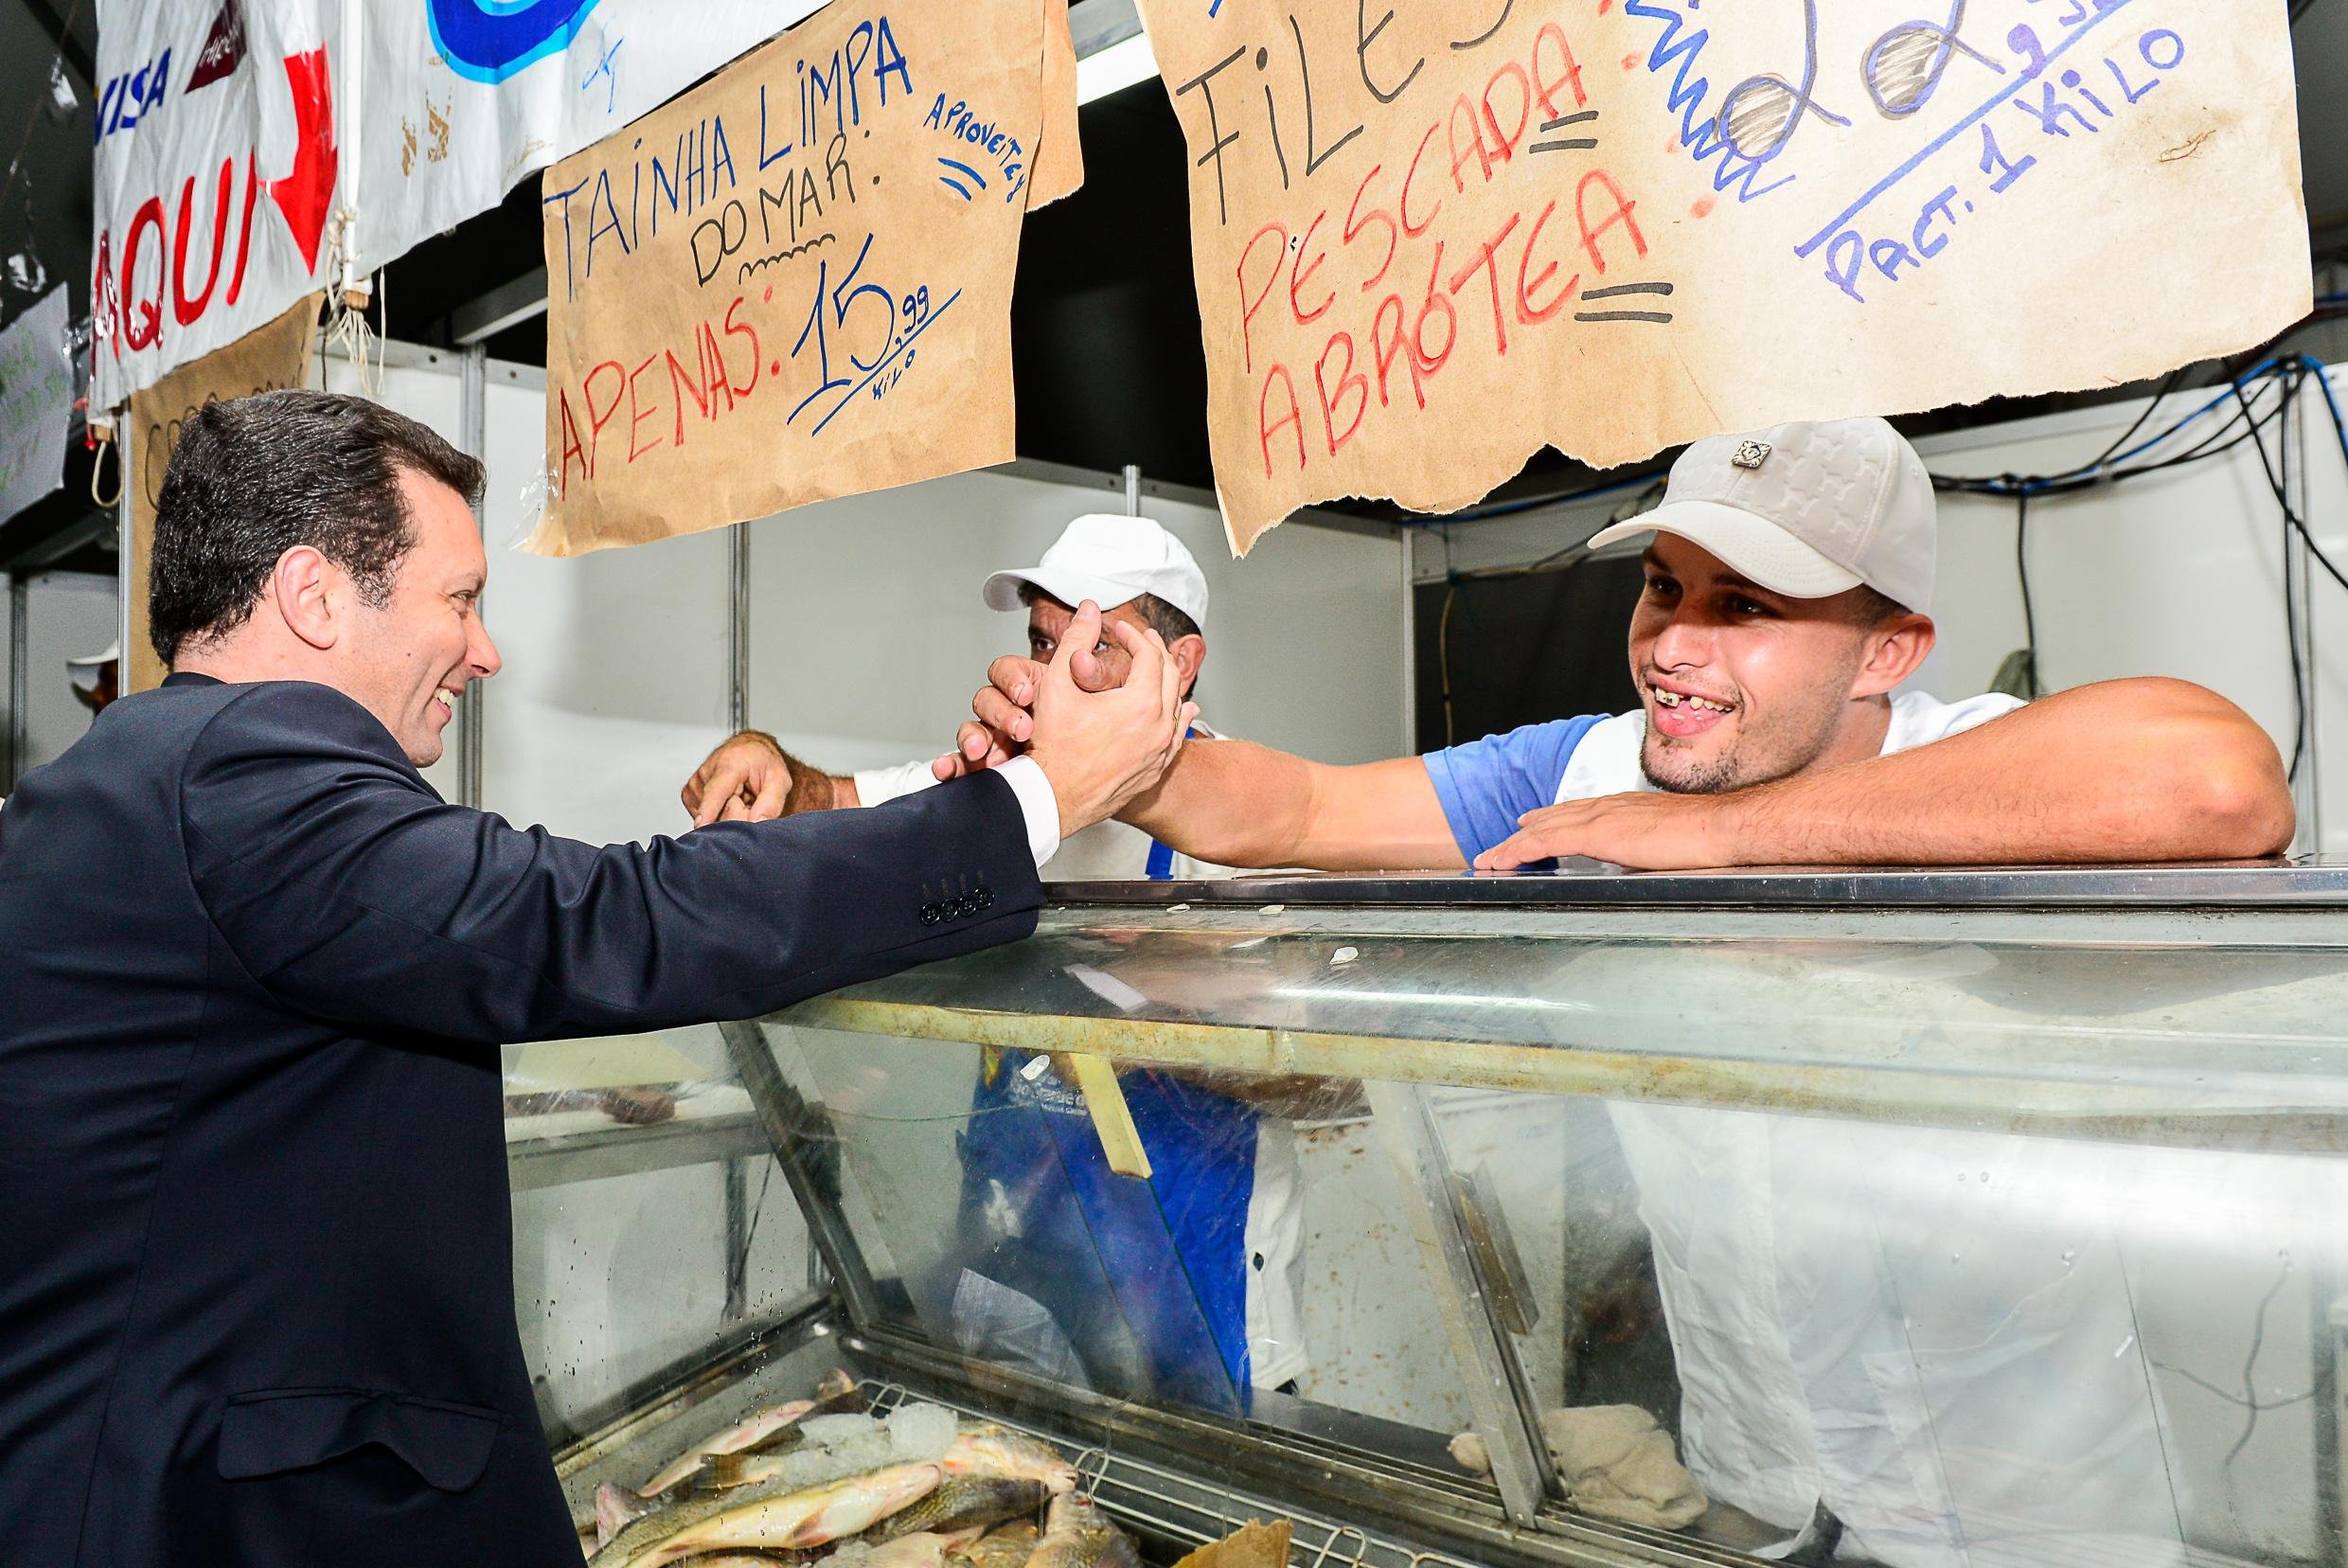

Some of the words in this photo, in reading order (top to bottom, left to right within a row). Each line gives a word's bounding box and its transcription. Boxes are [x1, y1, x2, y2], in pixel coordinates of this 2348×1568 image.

[1236, 22, 1589, 374] PESCADA
[1978, 122, 2037, 194] 1
[91, 145, 257, 377] AQUI
[690, 200, 747, 287] DO
